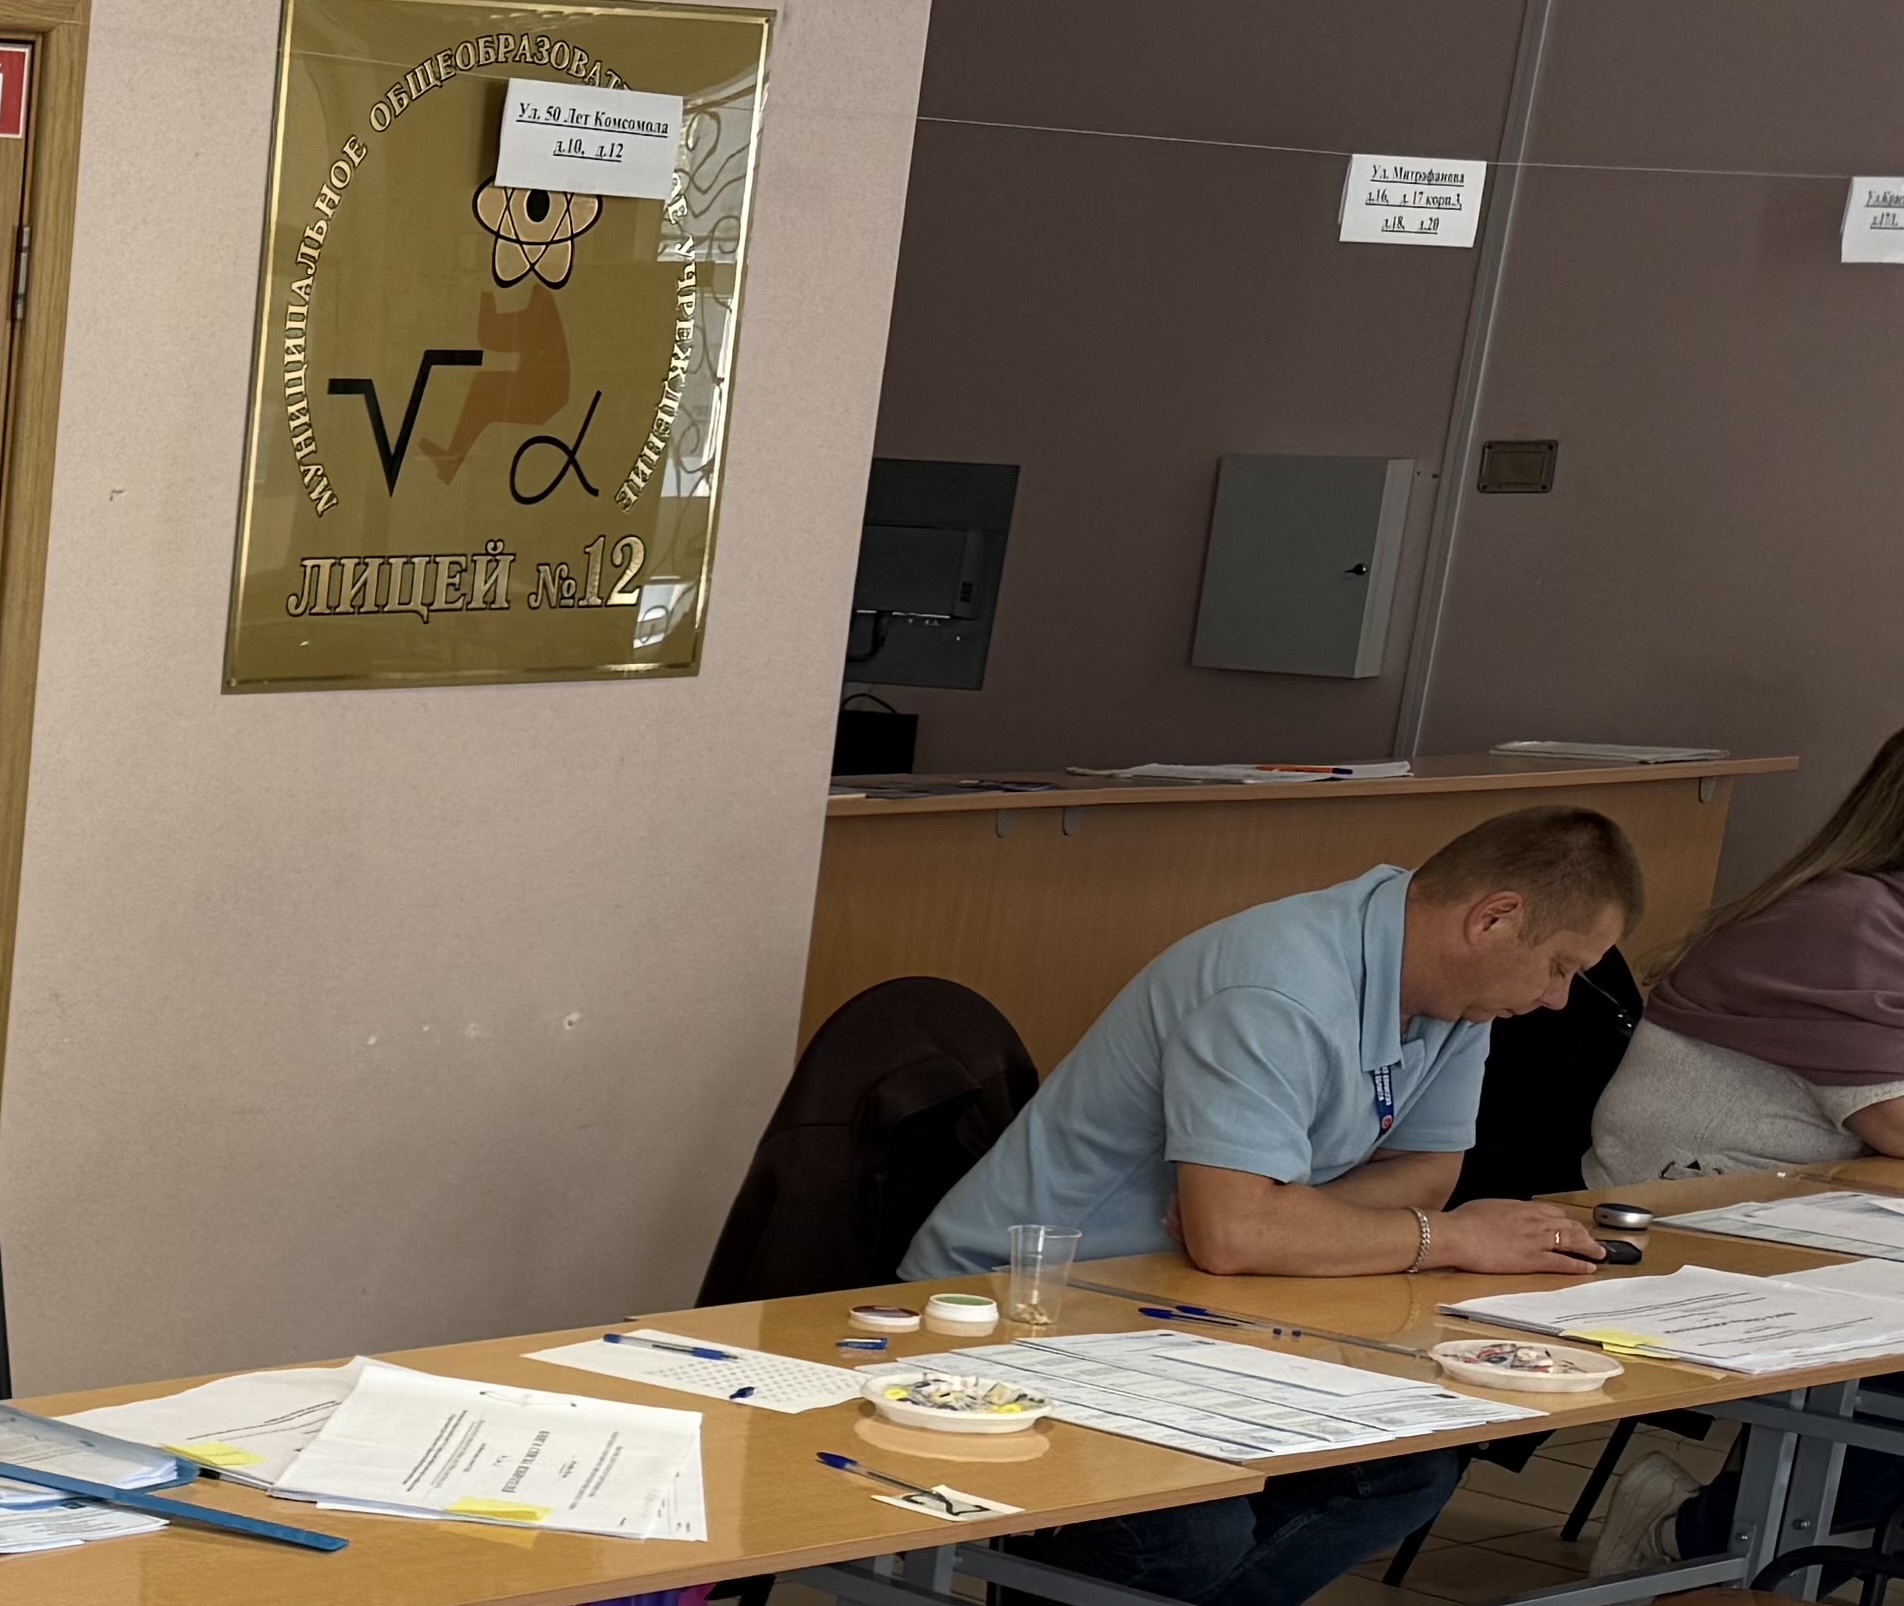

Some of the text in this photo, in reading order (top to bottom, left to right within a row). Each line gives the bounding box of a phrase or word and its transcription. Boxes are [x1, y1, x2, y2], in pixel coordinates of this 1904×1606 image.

[518, 102, 669, 135] Ул. 50 Лет Комсомола
[595, 143, 624, 159] д.12
[284, 134, 368, 517] МУНИЦИПАЛЬНОЕ
[286, 538, 516, 624] ЛИЦЕЙ
